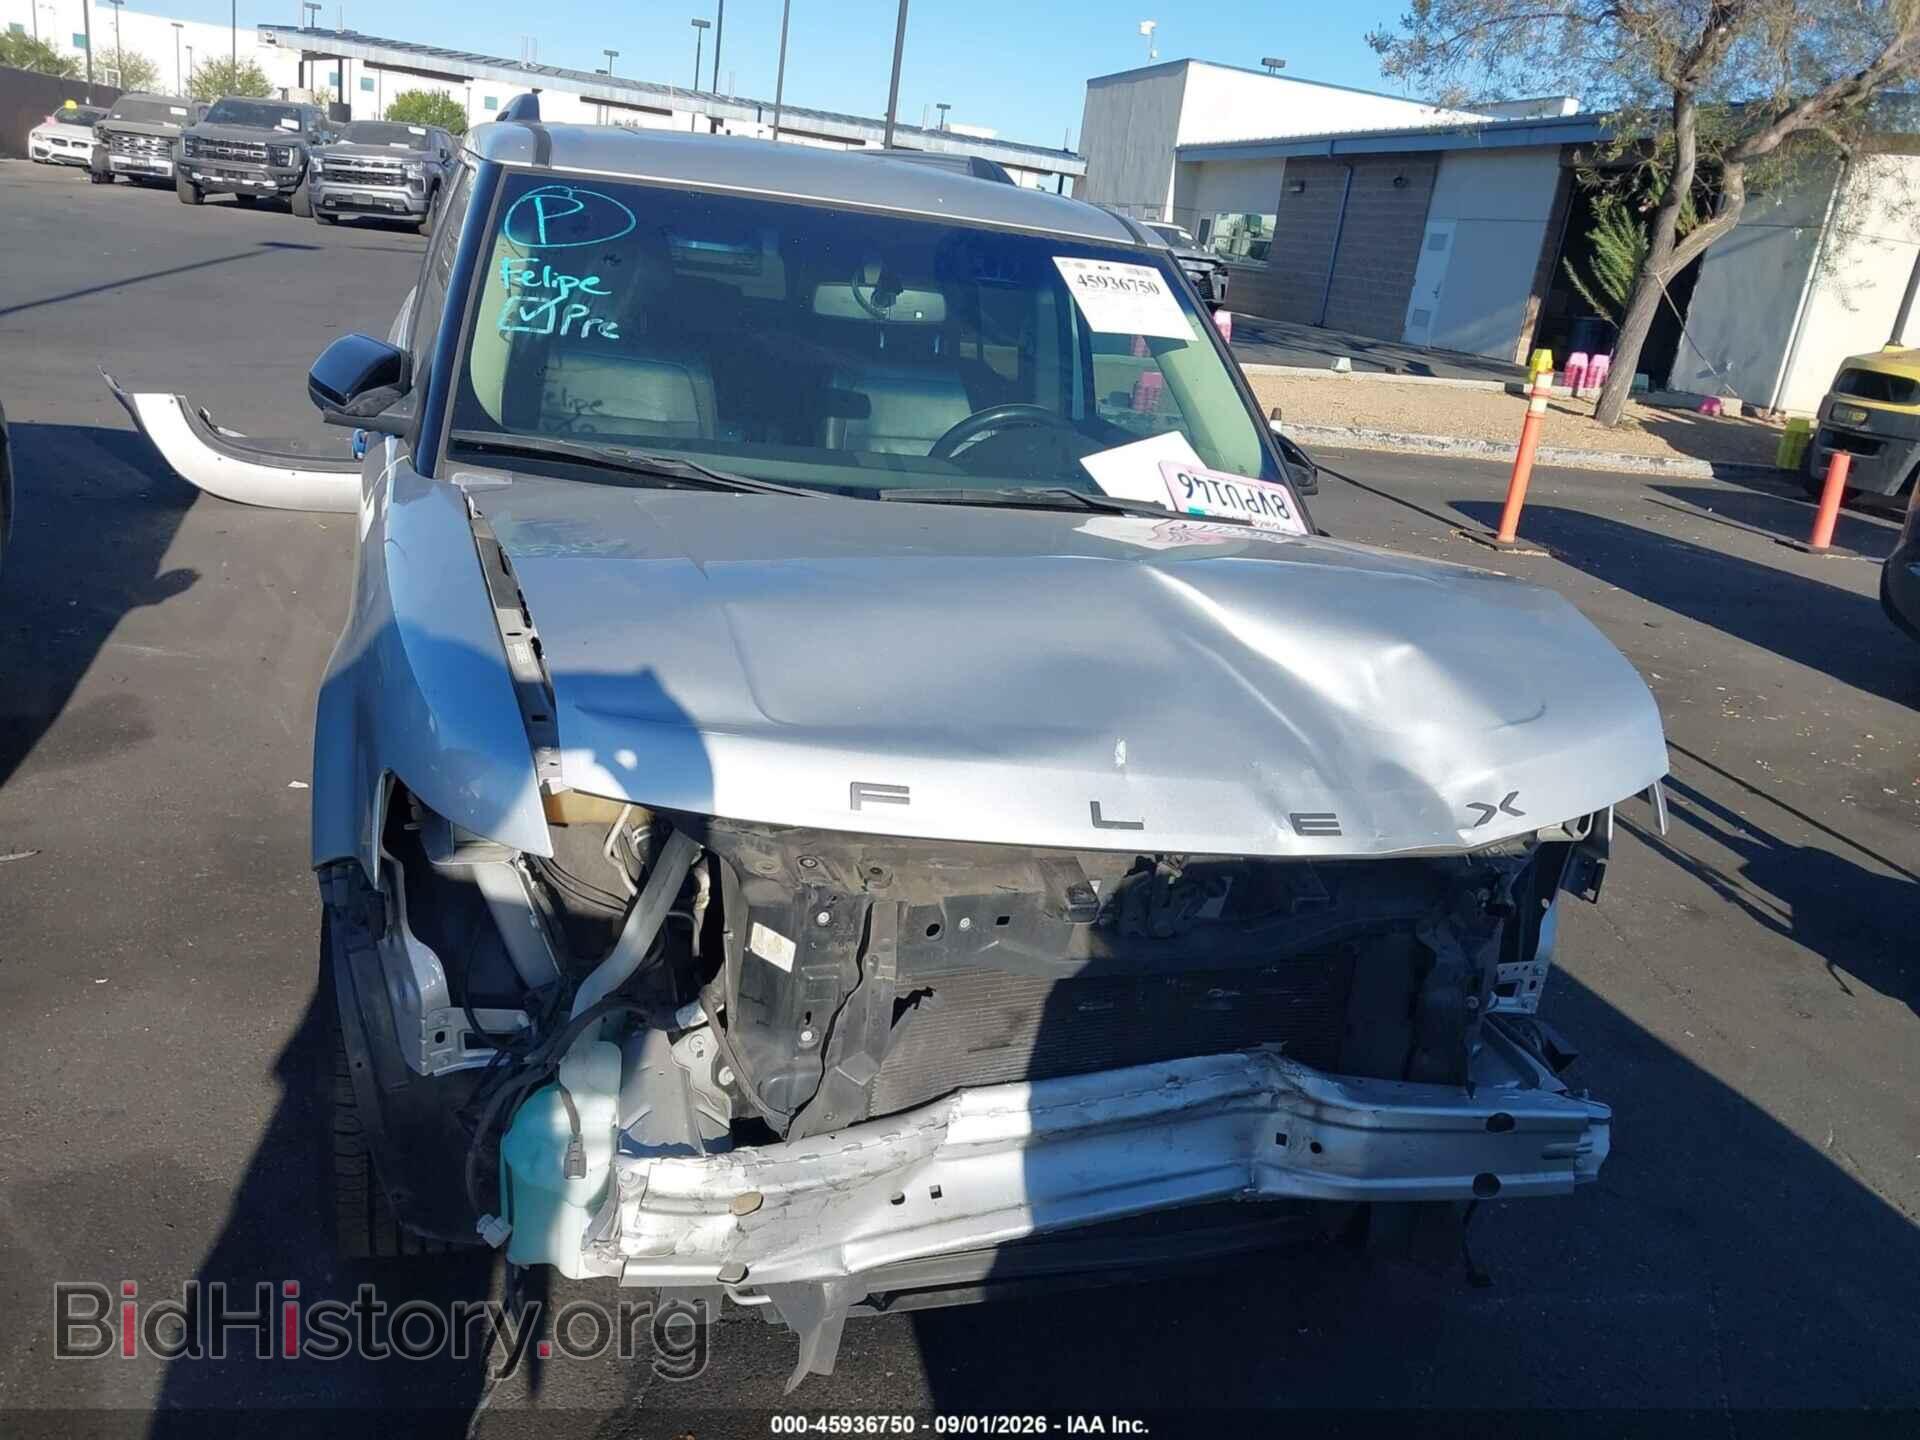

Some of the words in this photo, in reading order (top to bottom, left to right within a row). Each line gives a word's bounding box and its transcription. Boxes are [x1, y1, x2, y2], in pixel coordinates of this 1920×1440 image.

[500, 257, 612, 297] Felipe
[1077, 273, 1161, 295] 45936750
[560, 303, 620, 339] Pre
[1178, 472, 1290, 520] 8VPU146
[850, 781, 1526, 836] FLEX
